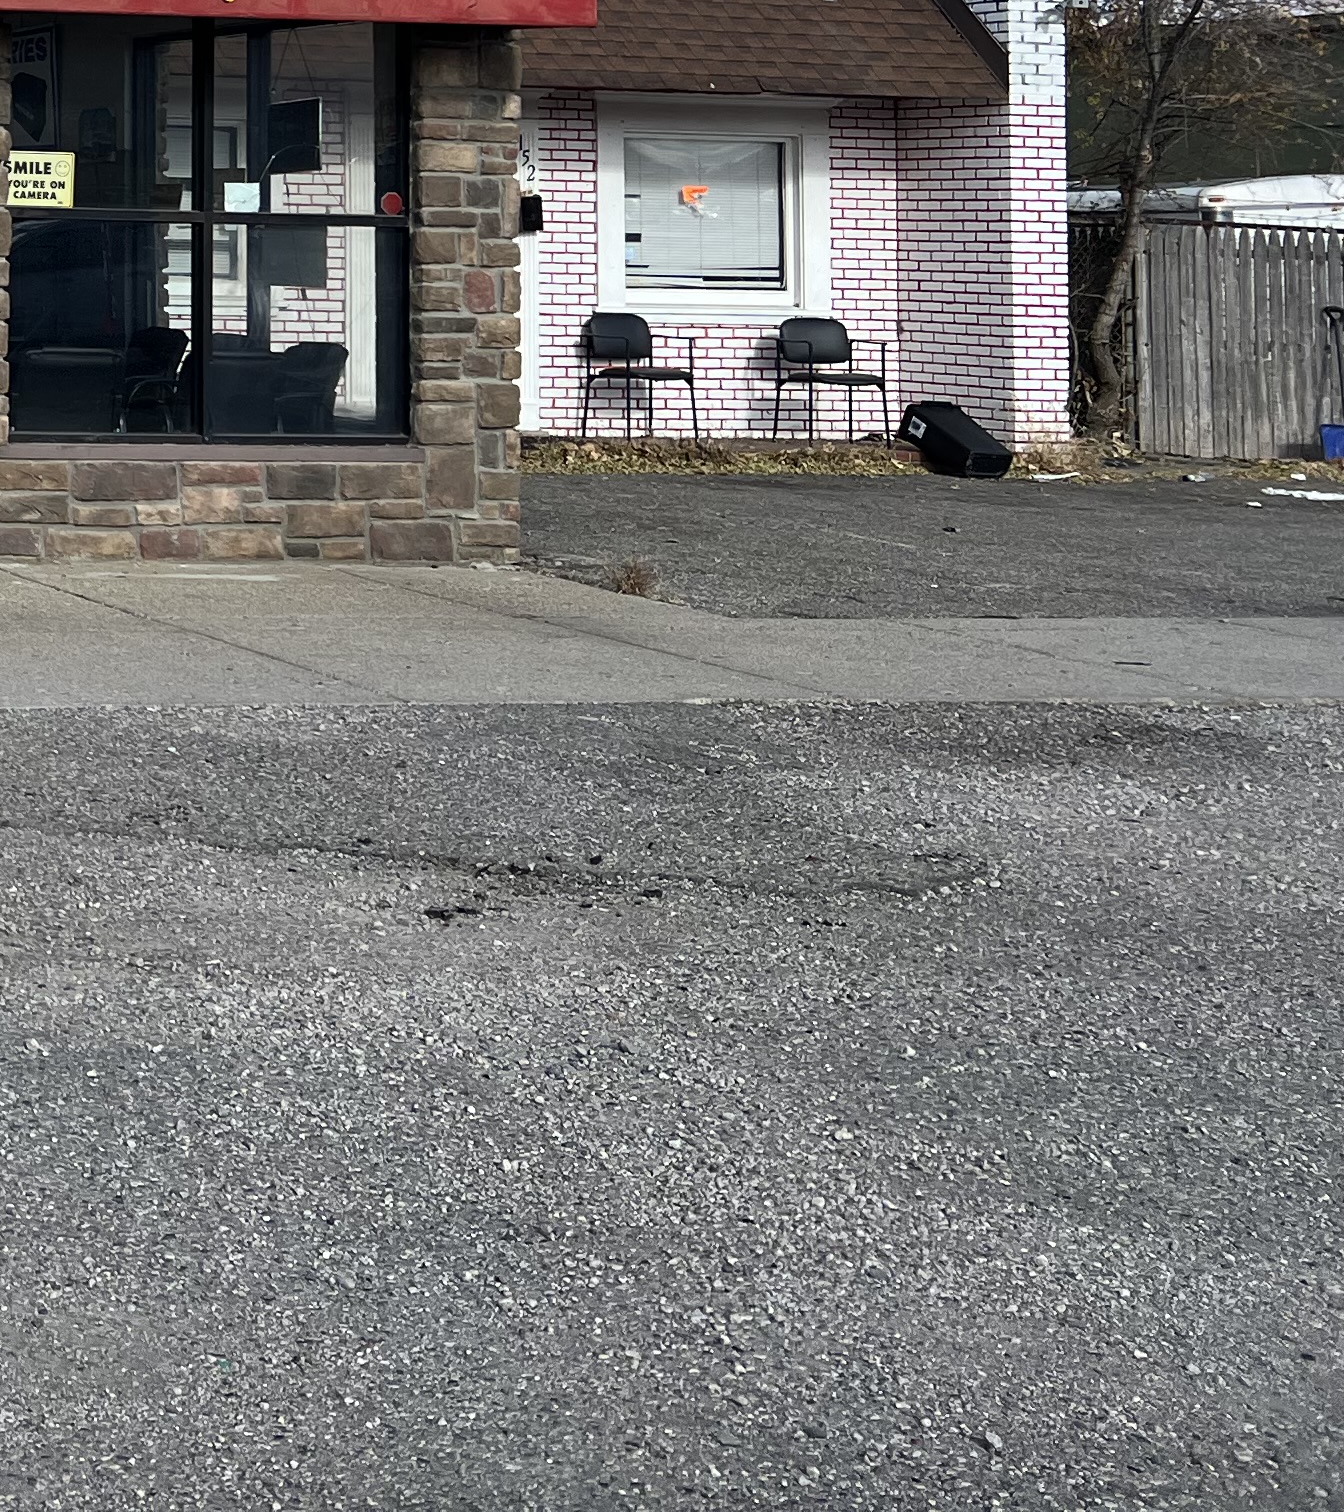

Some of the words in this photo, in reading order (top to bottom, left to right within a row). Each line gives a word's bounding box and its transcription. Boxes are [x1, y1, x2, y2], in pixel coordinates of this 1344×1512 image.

[3, 160, 52, 175] SMILE
[50, 180, 66, 190] ON
[13, 190, 57, 200] CAMERA
